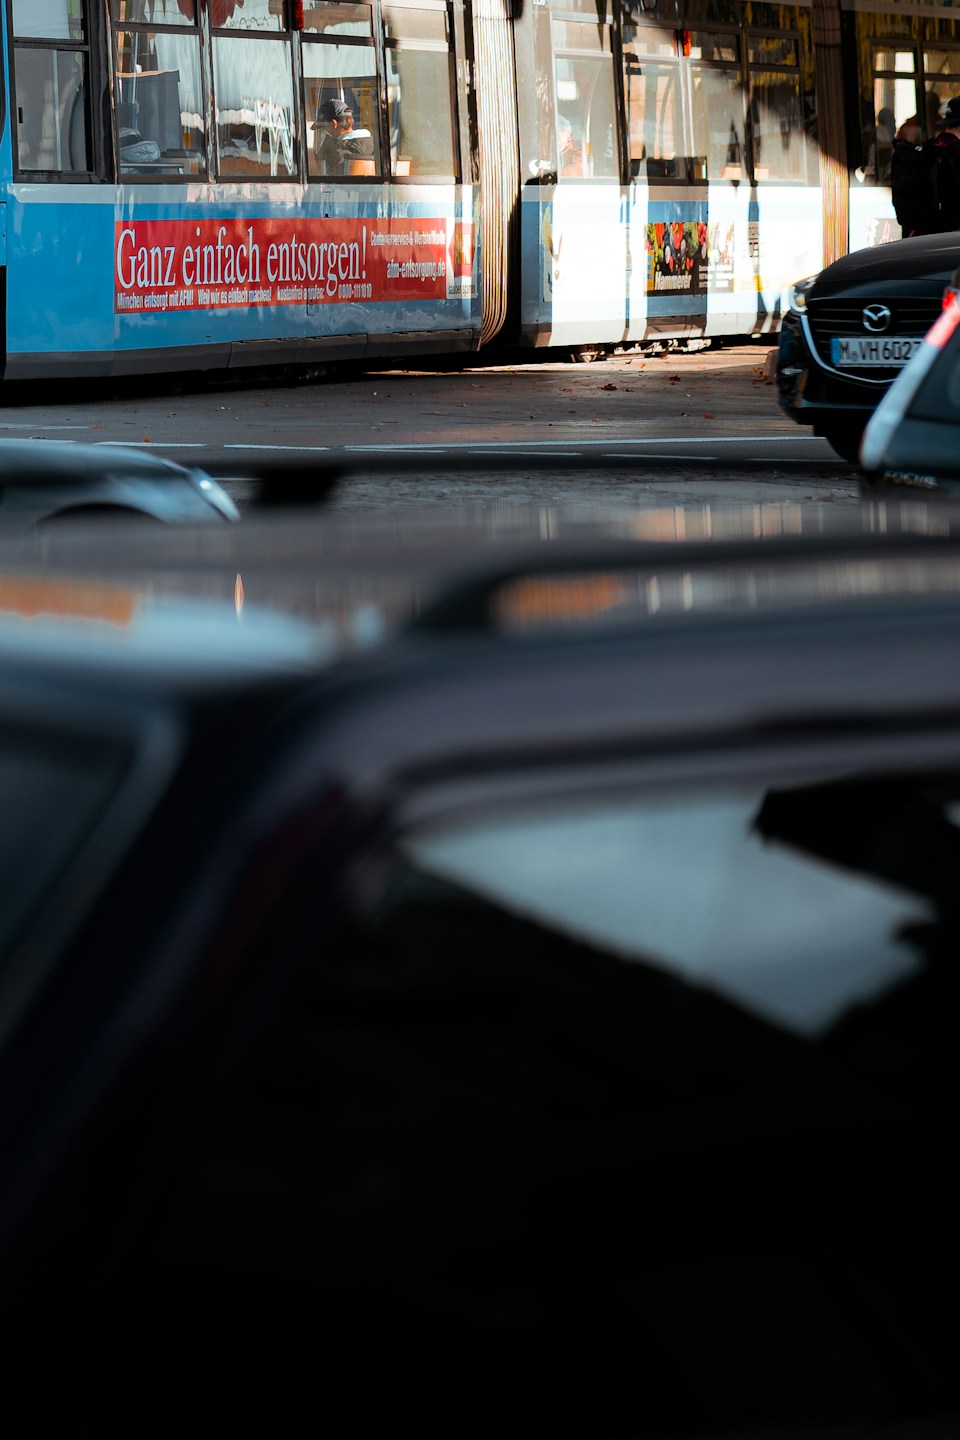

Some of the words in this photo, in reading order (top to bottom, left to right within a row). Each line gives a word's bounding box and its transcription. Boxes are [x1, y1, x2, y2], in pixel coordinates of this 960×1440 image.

[116, 228, 177, 289] Ganz
[182, 225, 261, 287] einfach
[266, 224, 368, 297] entsorgen!
[386, 258, 446, 282] afm-entsorgung.de
[117, 291, 143, 309] München
[144, 289, 169, 311] entsorgt
[169, 289, 179, 307] mit
[197, 288, 210, 305] Weil
[210, 287, 221, 304] wir
[220, 290, 228, 304] es
[227, 287, 248, 303] einfach
[249, 286, 272, 303] machen!
